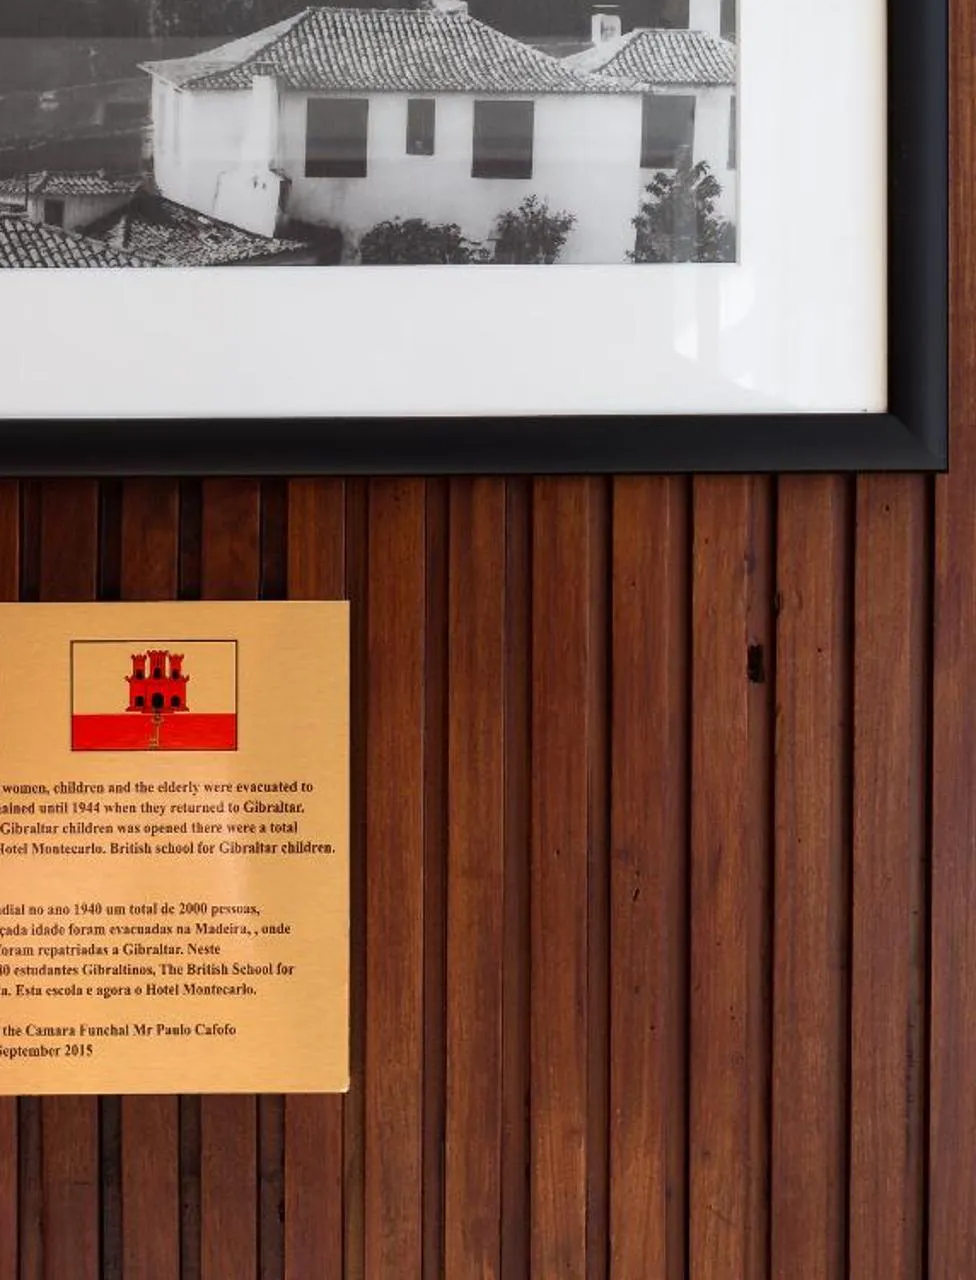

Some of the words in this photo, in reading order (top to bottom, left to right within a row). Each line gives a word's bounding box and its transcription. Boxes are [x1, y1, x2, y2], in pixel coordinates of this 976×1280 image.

[53, 781, 104, 793] children
[108, 781, 130, 793] and
[134, 781, 154, 793] the
[157, 781, 199, 795] elderly
[203, 783, 232, 792] were
[236, 781, 297, 792] evacuated
[301, 782, 313, 792] to
[38, 802, 68, 813] until
[72, 801, 100, 813] 1944
[103, 802, 136, 813] when
[140, 801, 165, 816] they
[170, 801, 224, 813] returned
[228, 803, 239, 813] to
[243, 800, 304, 813] Gibraltar.
[0, 822, 59, 834] Gibraltar
[62, 822, 113, 834] children
[117, 824, 140, 833] was
[143, 822, 187, 836] opened
[191, 822, 222, 833] there
[226, 824, 256, 833] were
[258, 824, 266, 833] a
[270, 821, 297, 834] total
[31, 842, 106, 855] Montecarlo.
[110, 842, 152, 854] British
[155, 841, 193, 854] school
[197, 841, 215, 854] for
[219, 840, 278, 853] Gibraltar
[280, 840, 335, 854] children.
[28, 906, 44, 915] no
[47, 905, 70, 915] ano
[74, 902, 102, 914] 1940
[105, 906, 125, 915] um
[129, 902, 157, 915] total
[160, 902, 175, 914] de
[178, 902, 207, 915] 2000
[31, 923, 65, 936] idade
[68, 920, 105, 935] foram
[108, 923, 172, 934] evacuadas
[176, 926, 191, 934] na
[260, 922, 290, 934] onde
[38, 943, 108, 958] repatriadas
[112, 946, 119, 954] a
[122, 943, 183, 955] Gibraltar.
[187, 943, 220, 954] Neste
[13, 964, 79, 976] estudantes
[158, 963, 183, 975] The
[186, 963, 228, 975] British
[231, 962, 273, 975] School
[276, 962, 294, 975] for
[15, 984, 42, 997] Esta
[45, 984, 83, 996] escola
[86, 987, 92, 995] e
[96, 986, 131, 998] agora
[134, 986, 142, 995] o
[145, 982, 179, 995] Hotel
[182, 983, 256, 995] Montecarlo.
[2, 1024, 22, 1036] the
[25, 1023, 75, 1036] Camara
[79, 1023, 129, 1036] Funchal
[132, 1023, 153, 1036] Mr
[156, 1023, 191, 1035] Paulo
[194, 1023, 236, 1035] Cafofo
[64, 1044, 93, 1057] 2015
